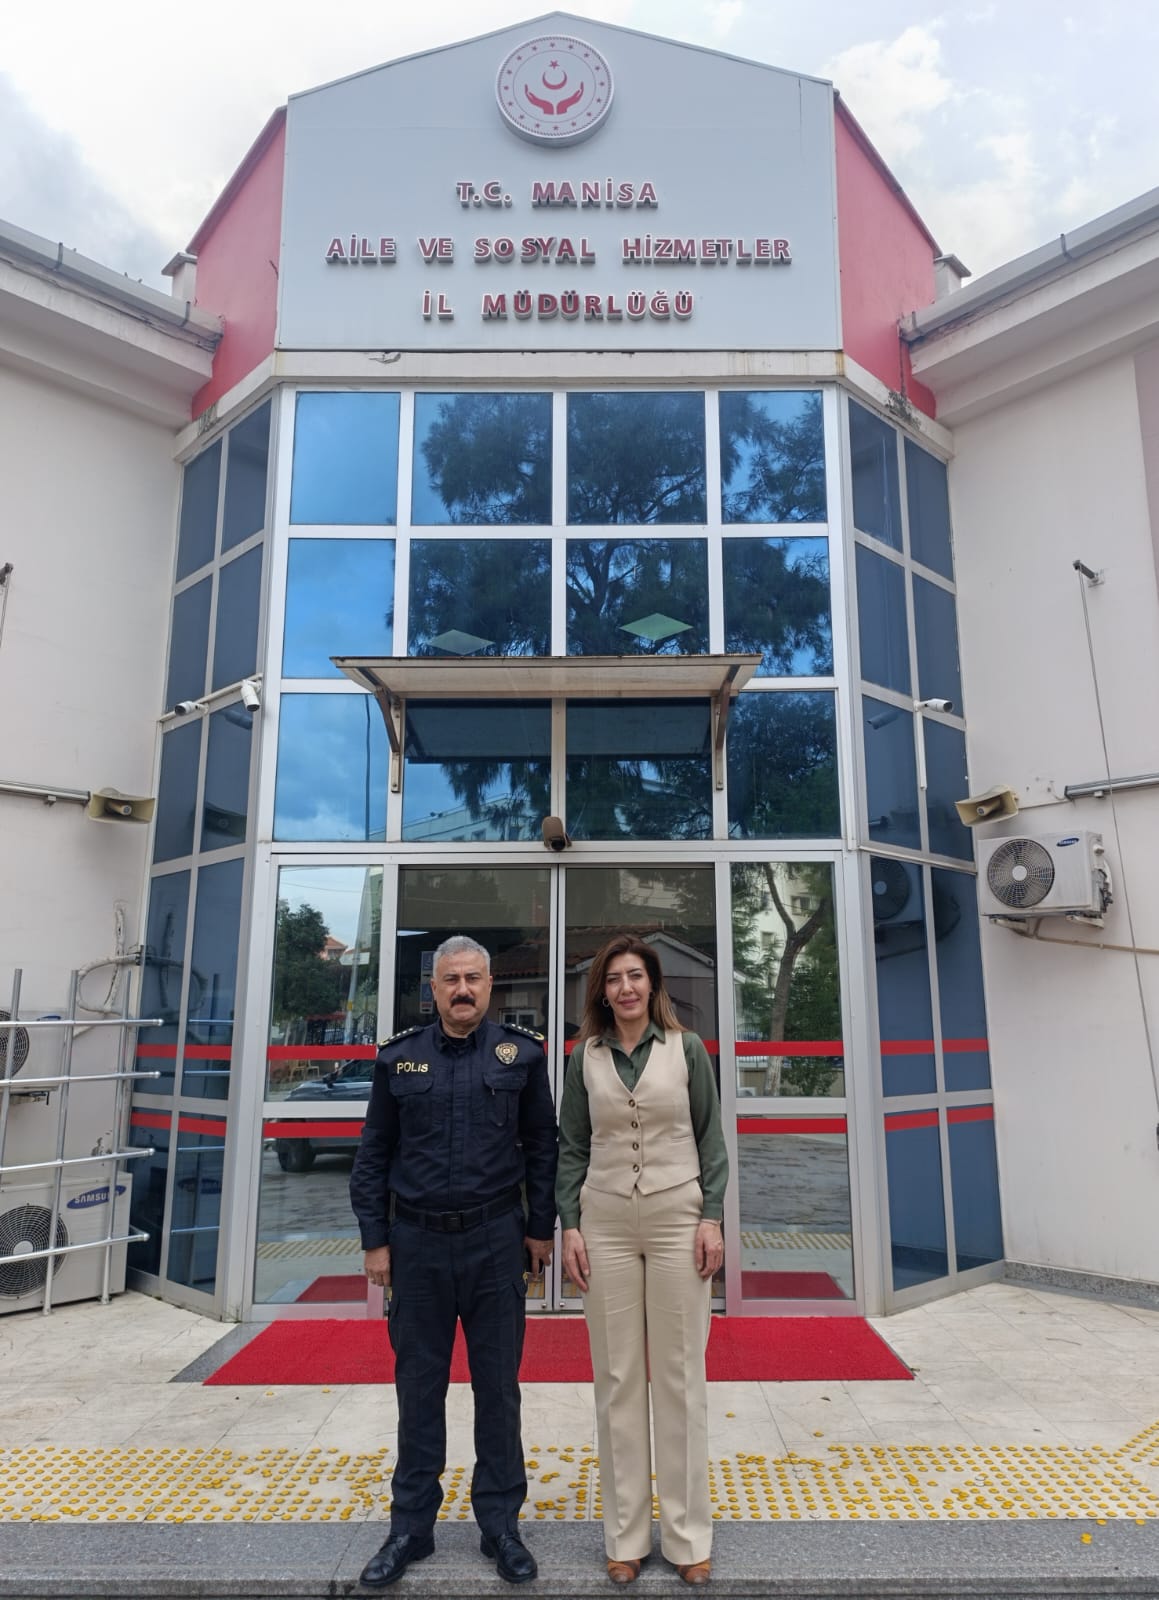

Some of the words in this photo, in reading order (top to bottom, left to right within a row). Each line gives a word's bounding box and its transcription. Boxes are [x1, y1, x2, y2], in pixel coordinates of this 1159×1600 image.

[456, 180, 512, 206] T.C.
[532, 177, 657, 206] MANİSA
[325, 233, 396, 262] AİLE
[418, 236, 453, 262] VE
[474, 235, 595, 262] SOSYAL
[622, 234, 792, 263] HİZMETLER
[422, 289, 454, 319] İL
[481, 289, 694, 319] MÜDÜRLÜĞÜ
[74, 1190, 120, 1204] SAMSU
